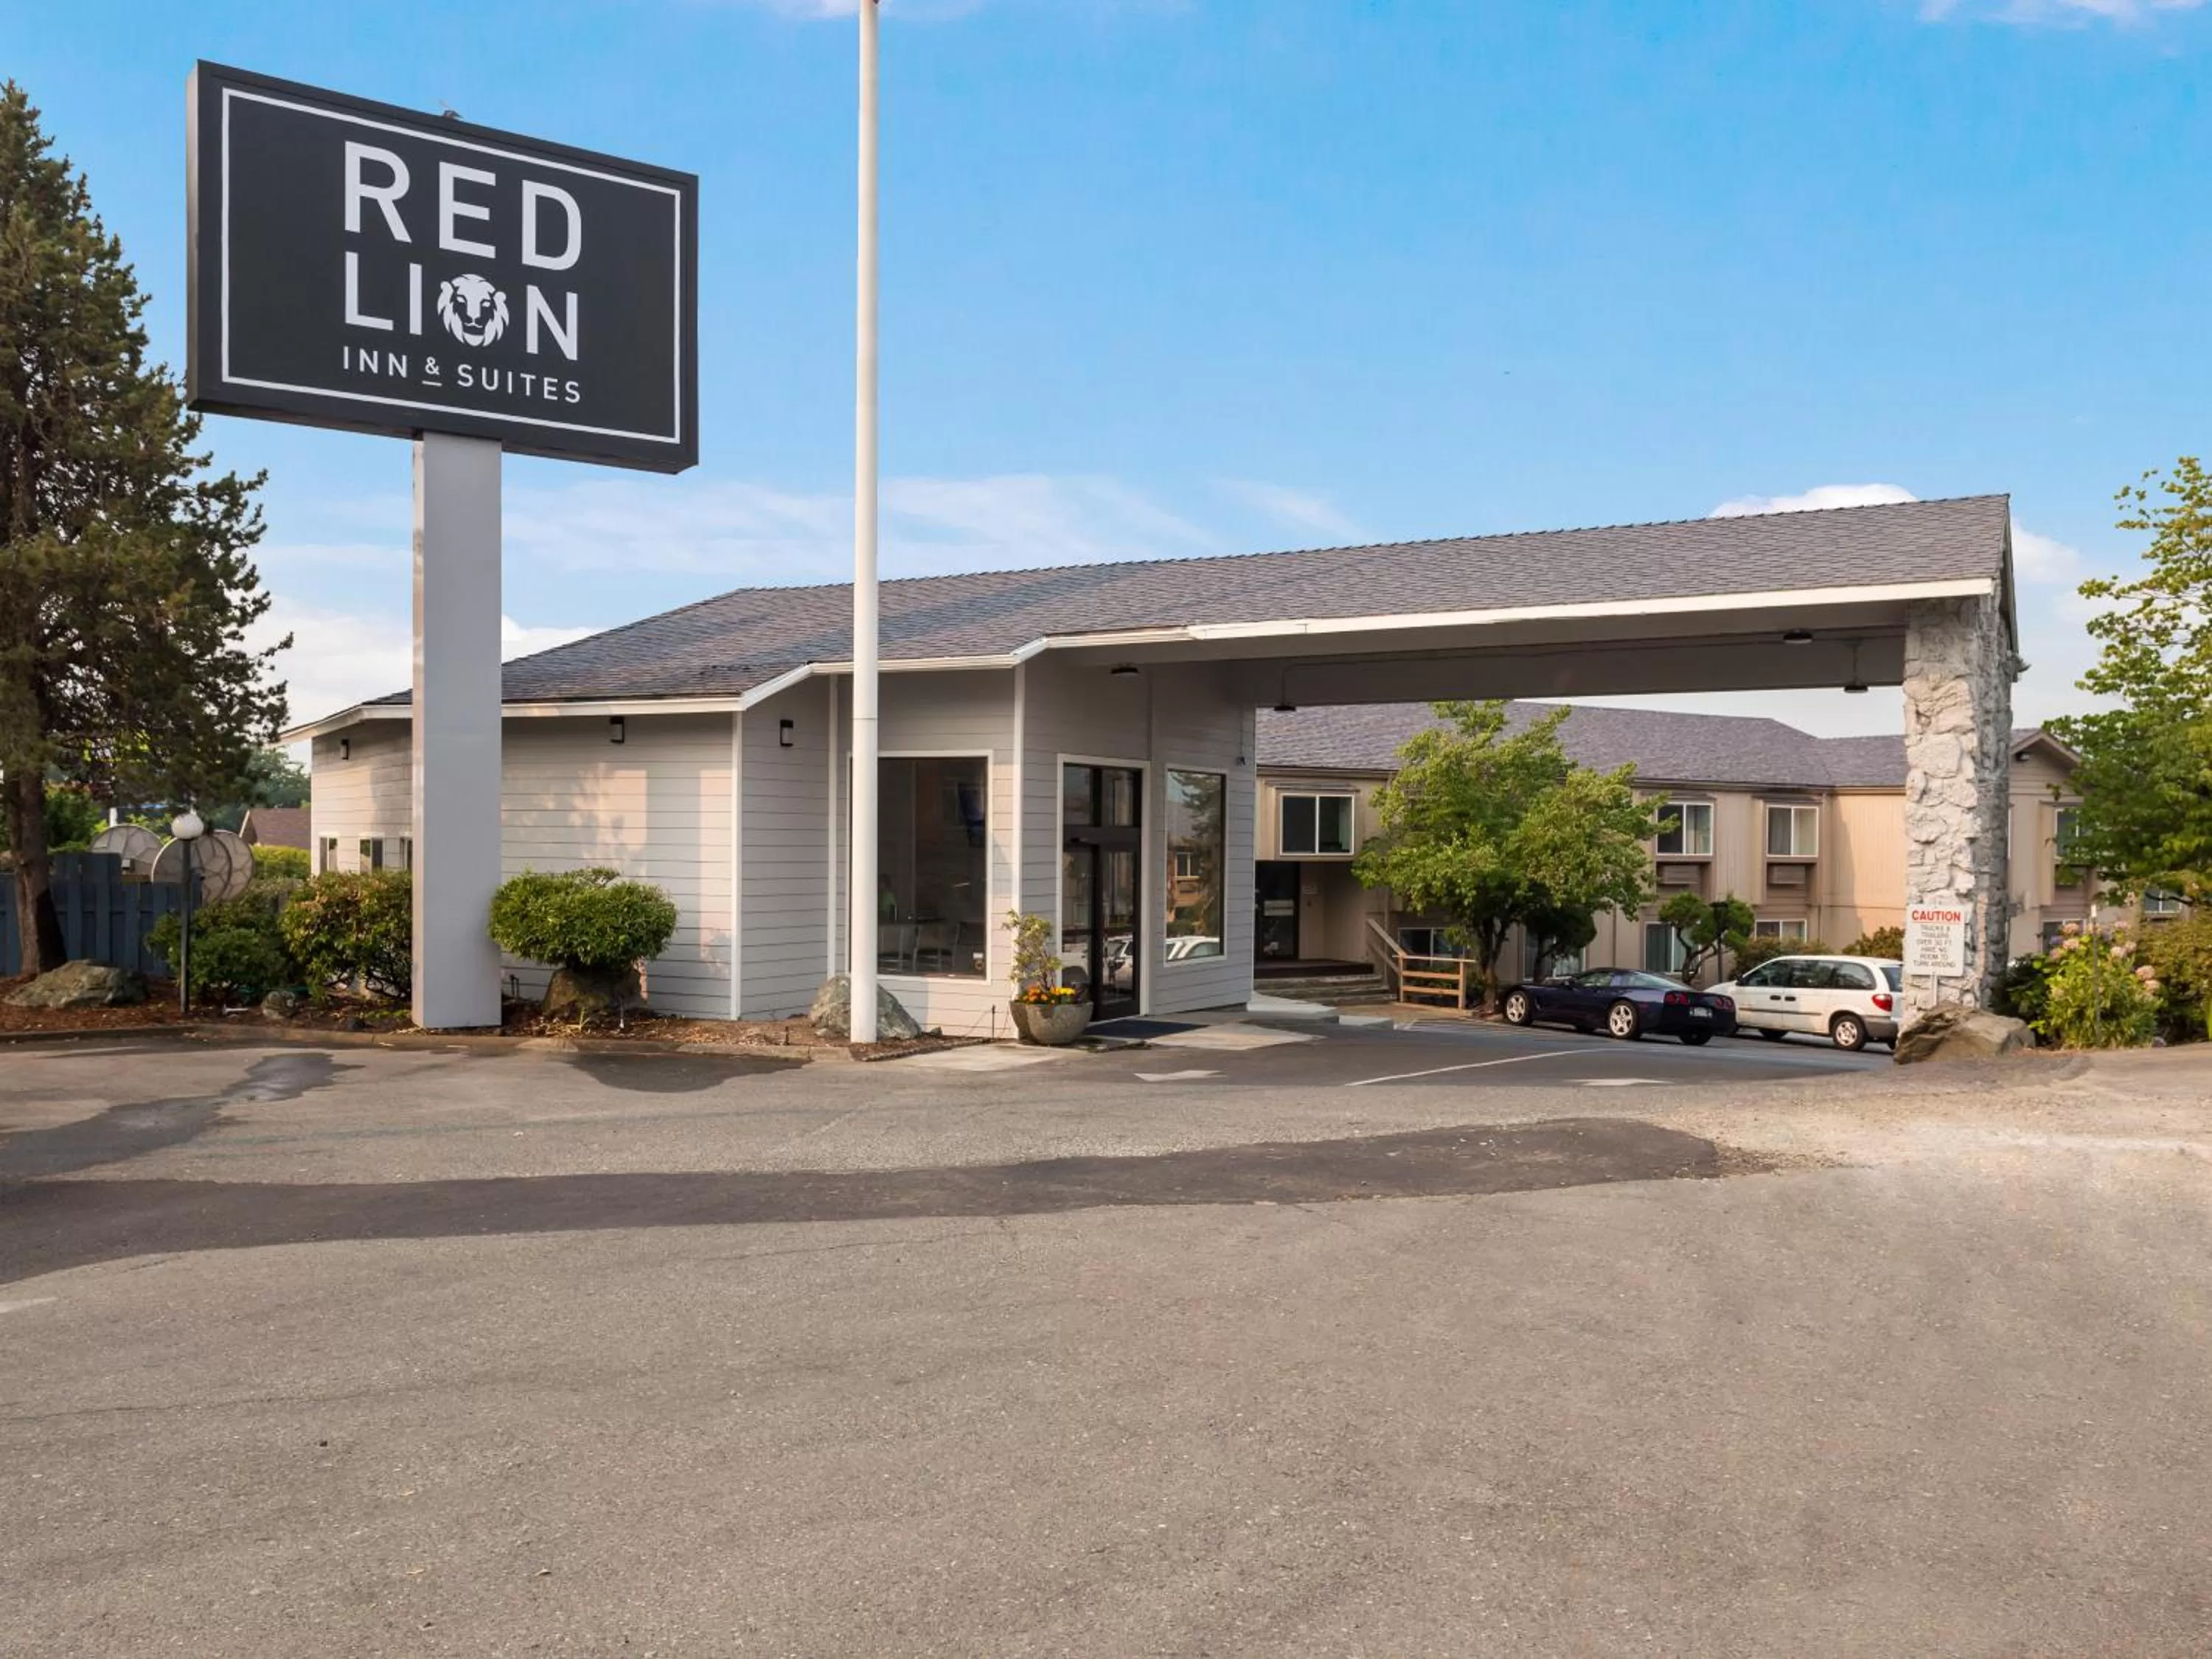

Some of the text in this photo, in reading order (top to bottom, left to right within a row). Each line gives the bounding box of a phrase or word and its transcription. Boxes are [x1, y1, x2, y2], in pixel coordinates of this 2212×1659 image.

[344, 140, 582, 271] RED
[344, 251, 579, 361] LIN
[343, 346, 581, 403] INN & SUITES
[1911, 910, 1961, 922] CAUTION
